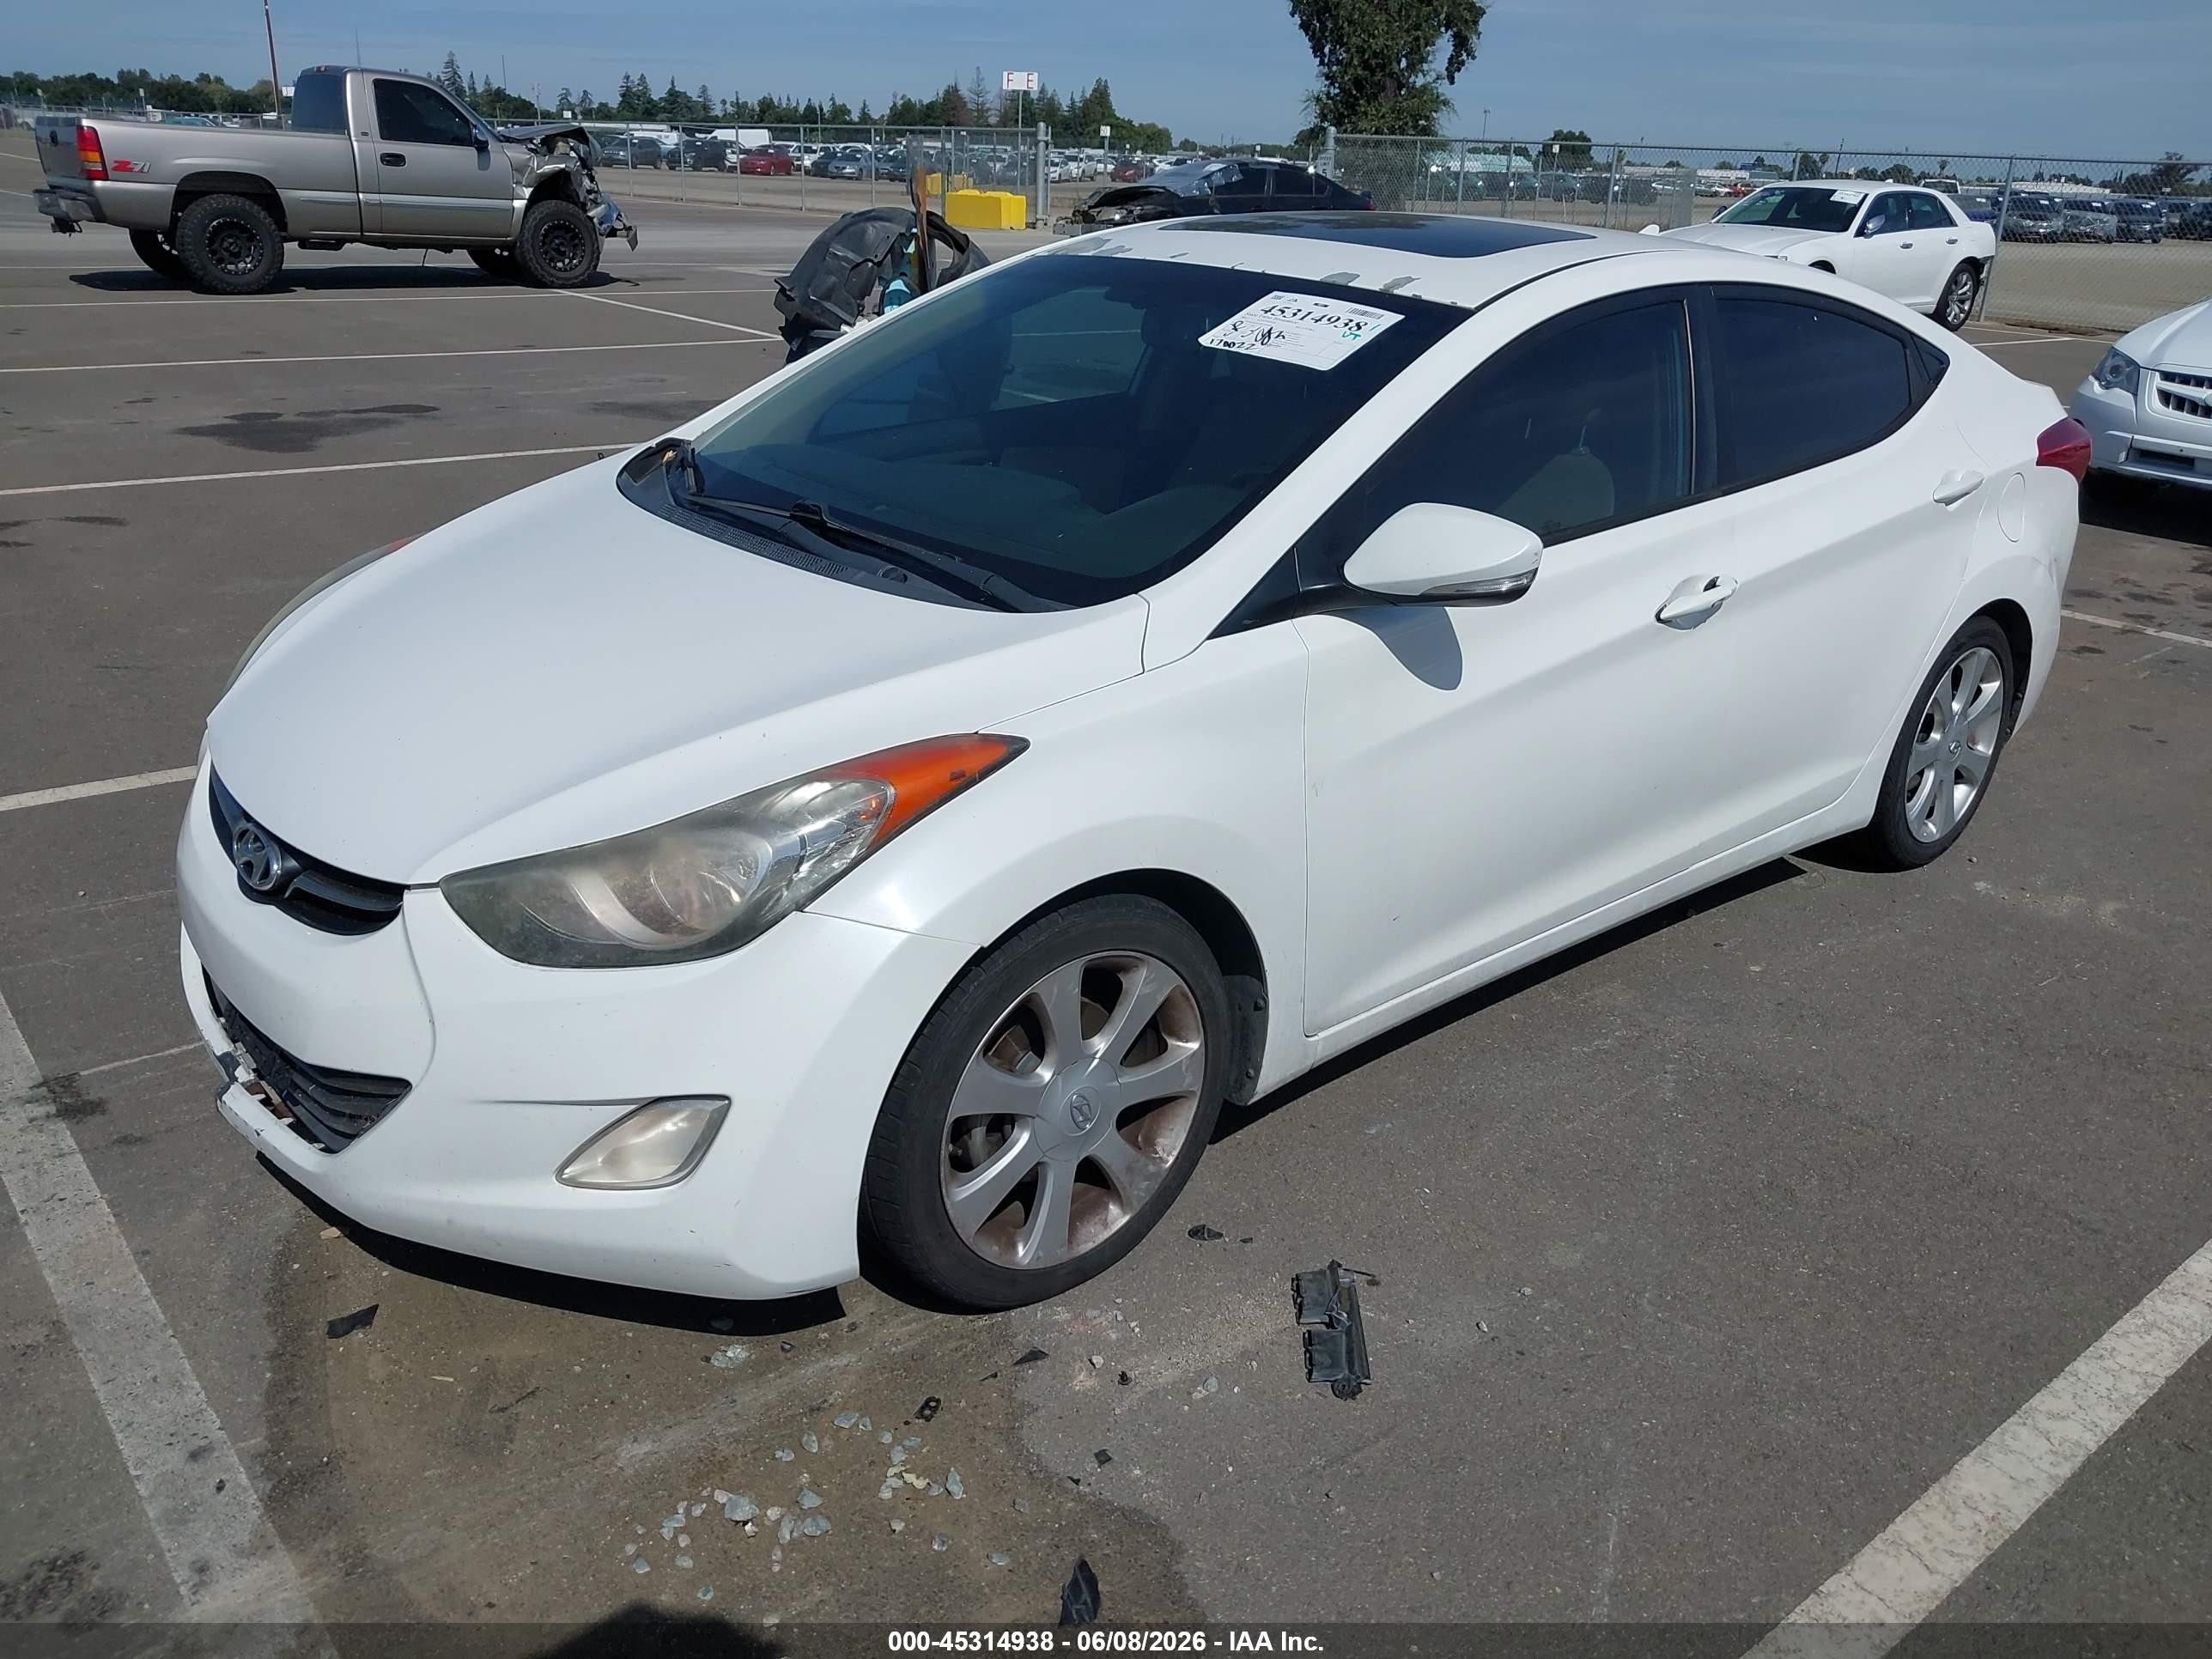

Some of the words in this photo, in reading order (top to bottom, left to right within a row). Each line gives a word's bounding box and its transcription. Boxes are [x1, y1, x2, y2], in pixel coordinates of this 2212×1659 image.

[1006, 72, 1014, 89] F
[1026, 72, 1034, 89] E
[110, 158, 151, 173] Z71
[1260, 304, 1369, 332] 45314938
